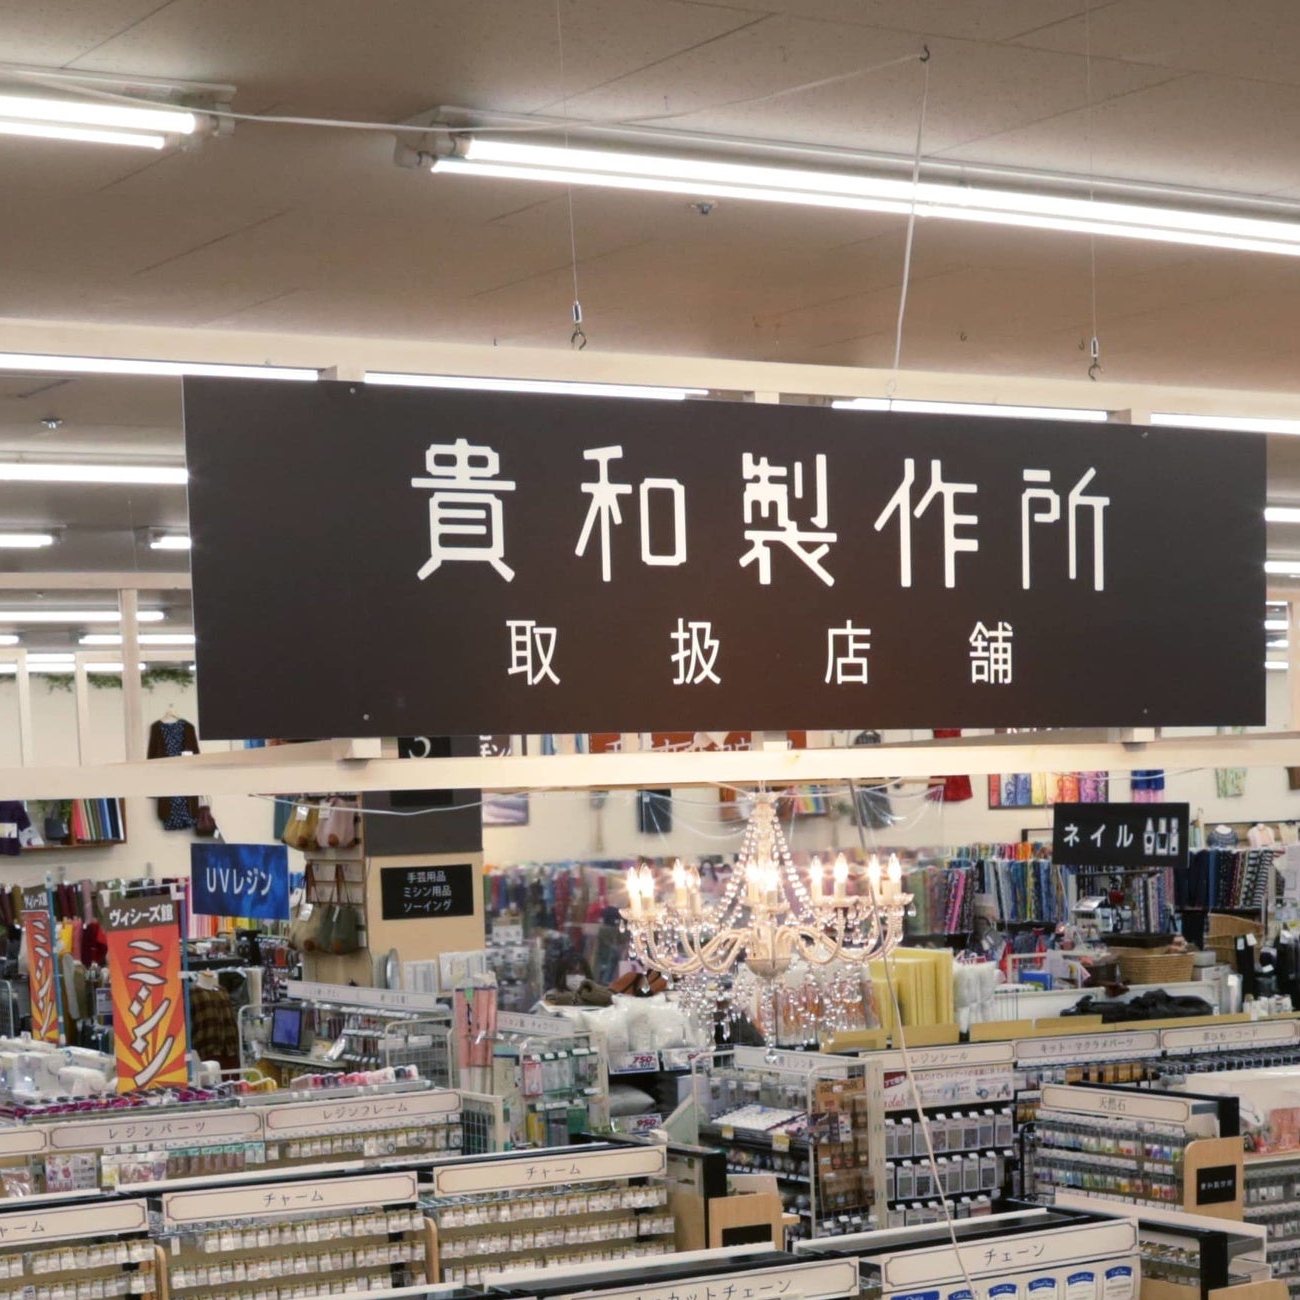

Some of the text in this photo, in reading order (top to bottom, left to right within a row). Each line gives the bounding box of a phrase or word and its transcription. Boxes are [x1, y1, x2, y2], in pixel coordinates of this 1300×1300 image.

[408, 438, 1112, 592] 貴和製作所
[505, 617, 1014, 687] 取扱店舗
[1063, 822, 1134, 849] ネイル
[205, 867, 273, 897] UVレジン
[406, 870, 447, 883] 手芸用品
[402, 884, 452, 898] ミシン用品
[108, 902, 174, 929] ヴィシーズ館
[402, 898, 452, 912] ソーイング
[32, 919, 52, 1039] ミシン
[127, 938, 175, 1088] ミシン
[322, 1101, 409, 1121] レジンフレーム
[1099, 1097, 1128, 1112] 天然石
[108, 1120, 207, 1140] レジンパーツ
[524, 1162, 583, 1180] チャーム
[263, 1188, 325, 1208] チャーム
[983, 1240, 1046, 1266] チェーン
